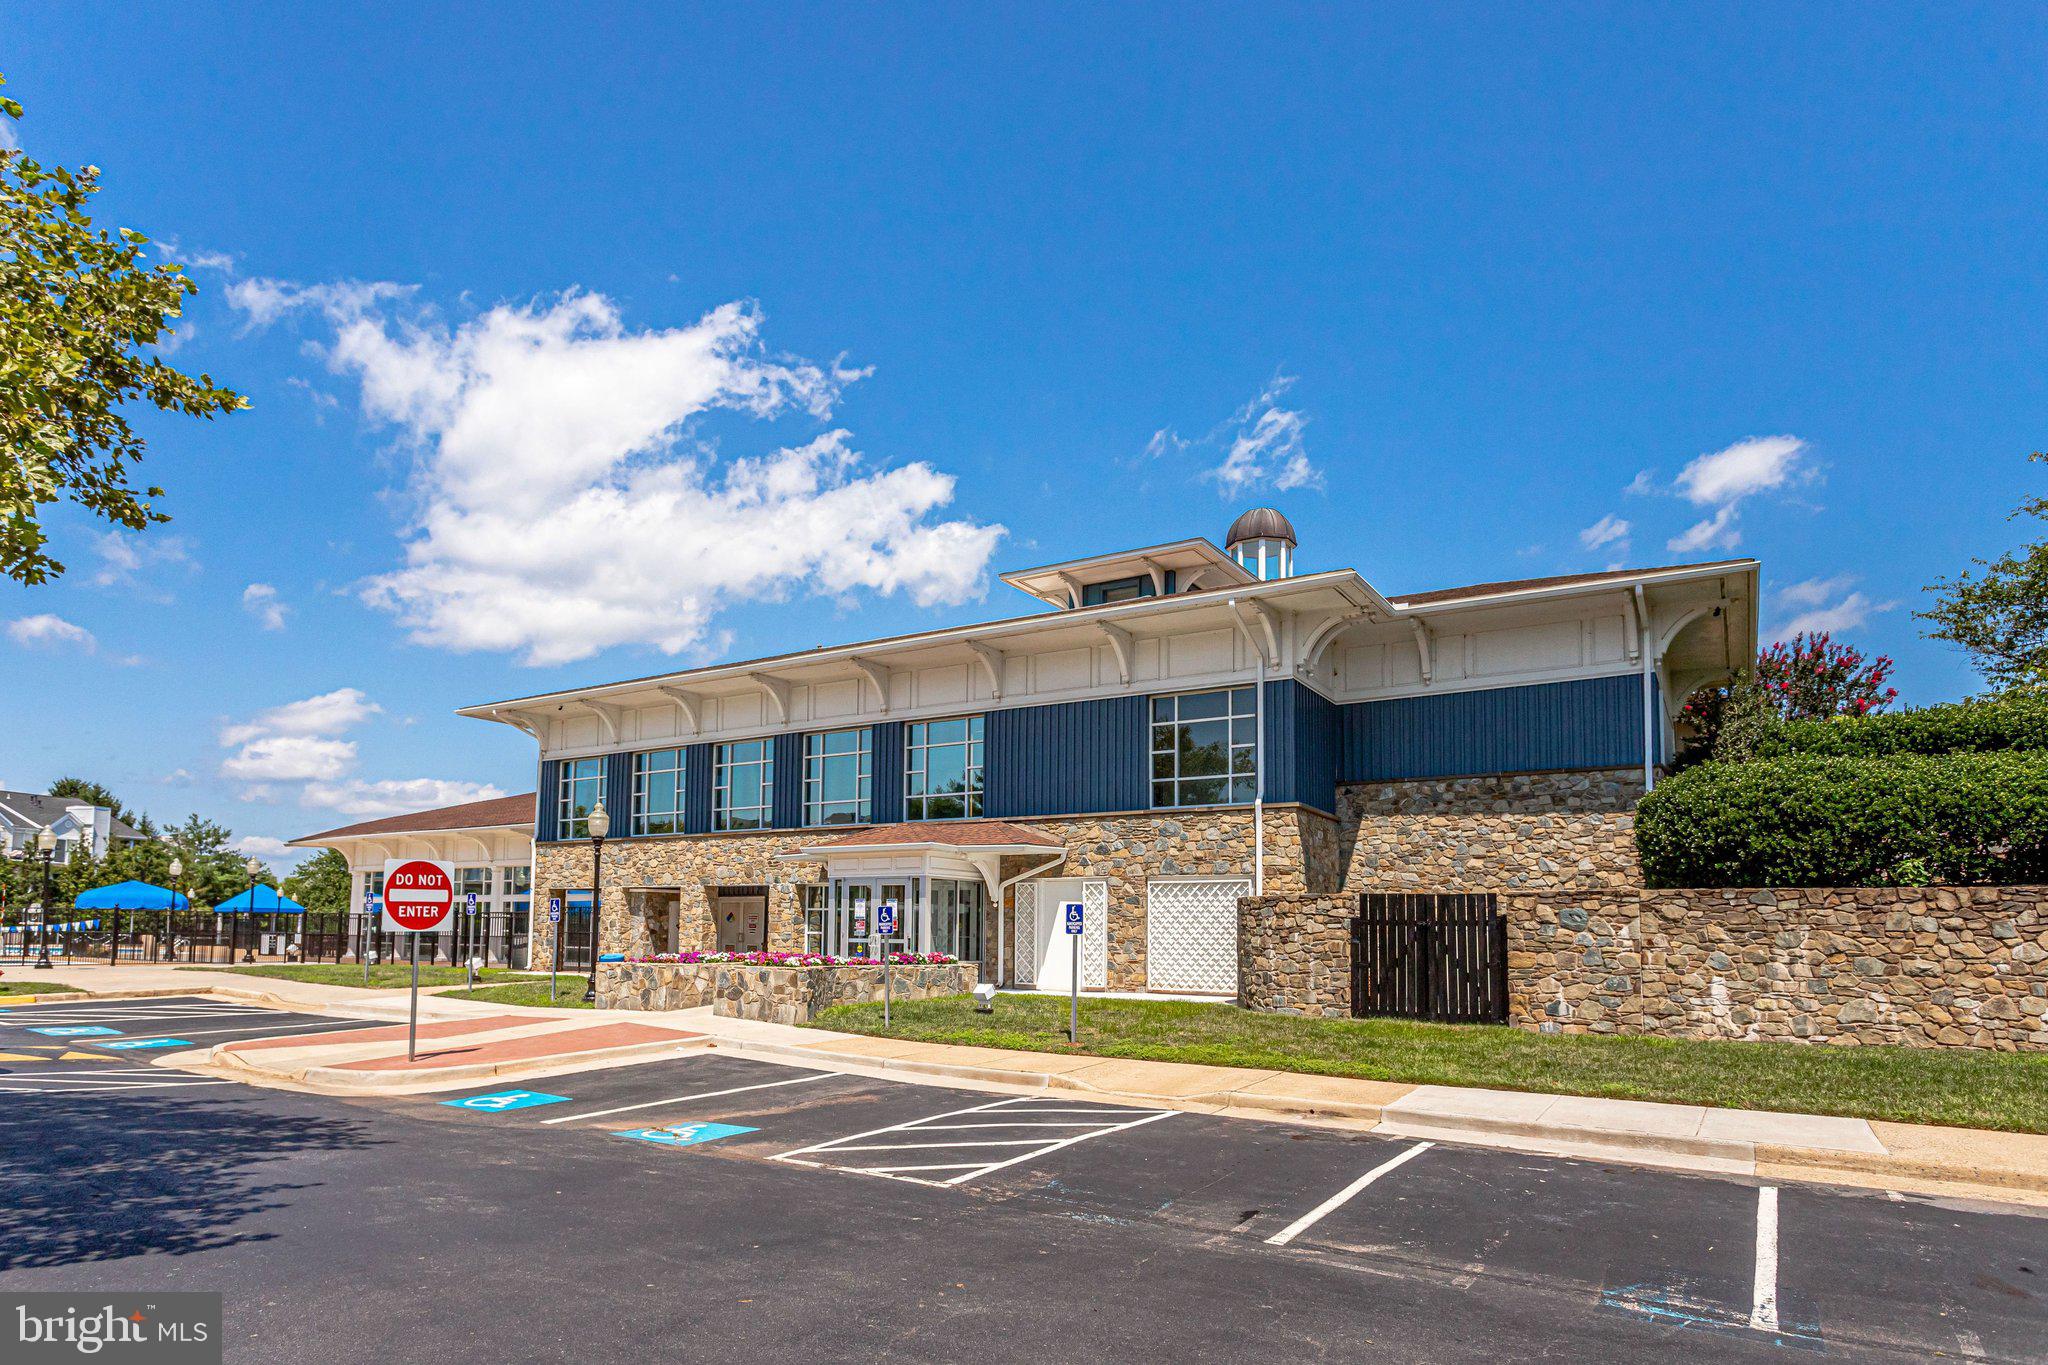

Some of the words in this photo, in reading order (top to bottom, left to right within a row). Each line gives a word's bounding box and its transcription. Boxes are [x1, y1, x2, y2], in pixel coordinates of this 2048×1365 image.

[395, 873, 413, 886] DO
[418, 874, 443, 886] NOT
[398, 905, 439, 918] ENTER
